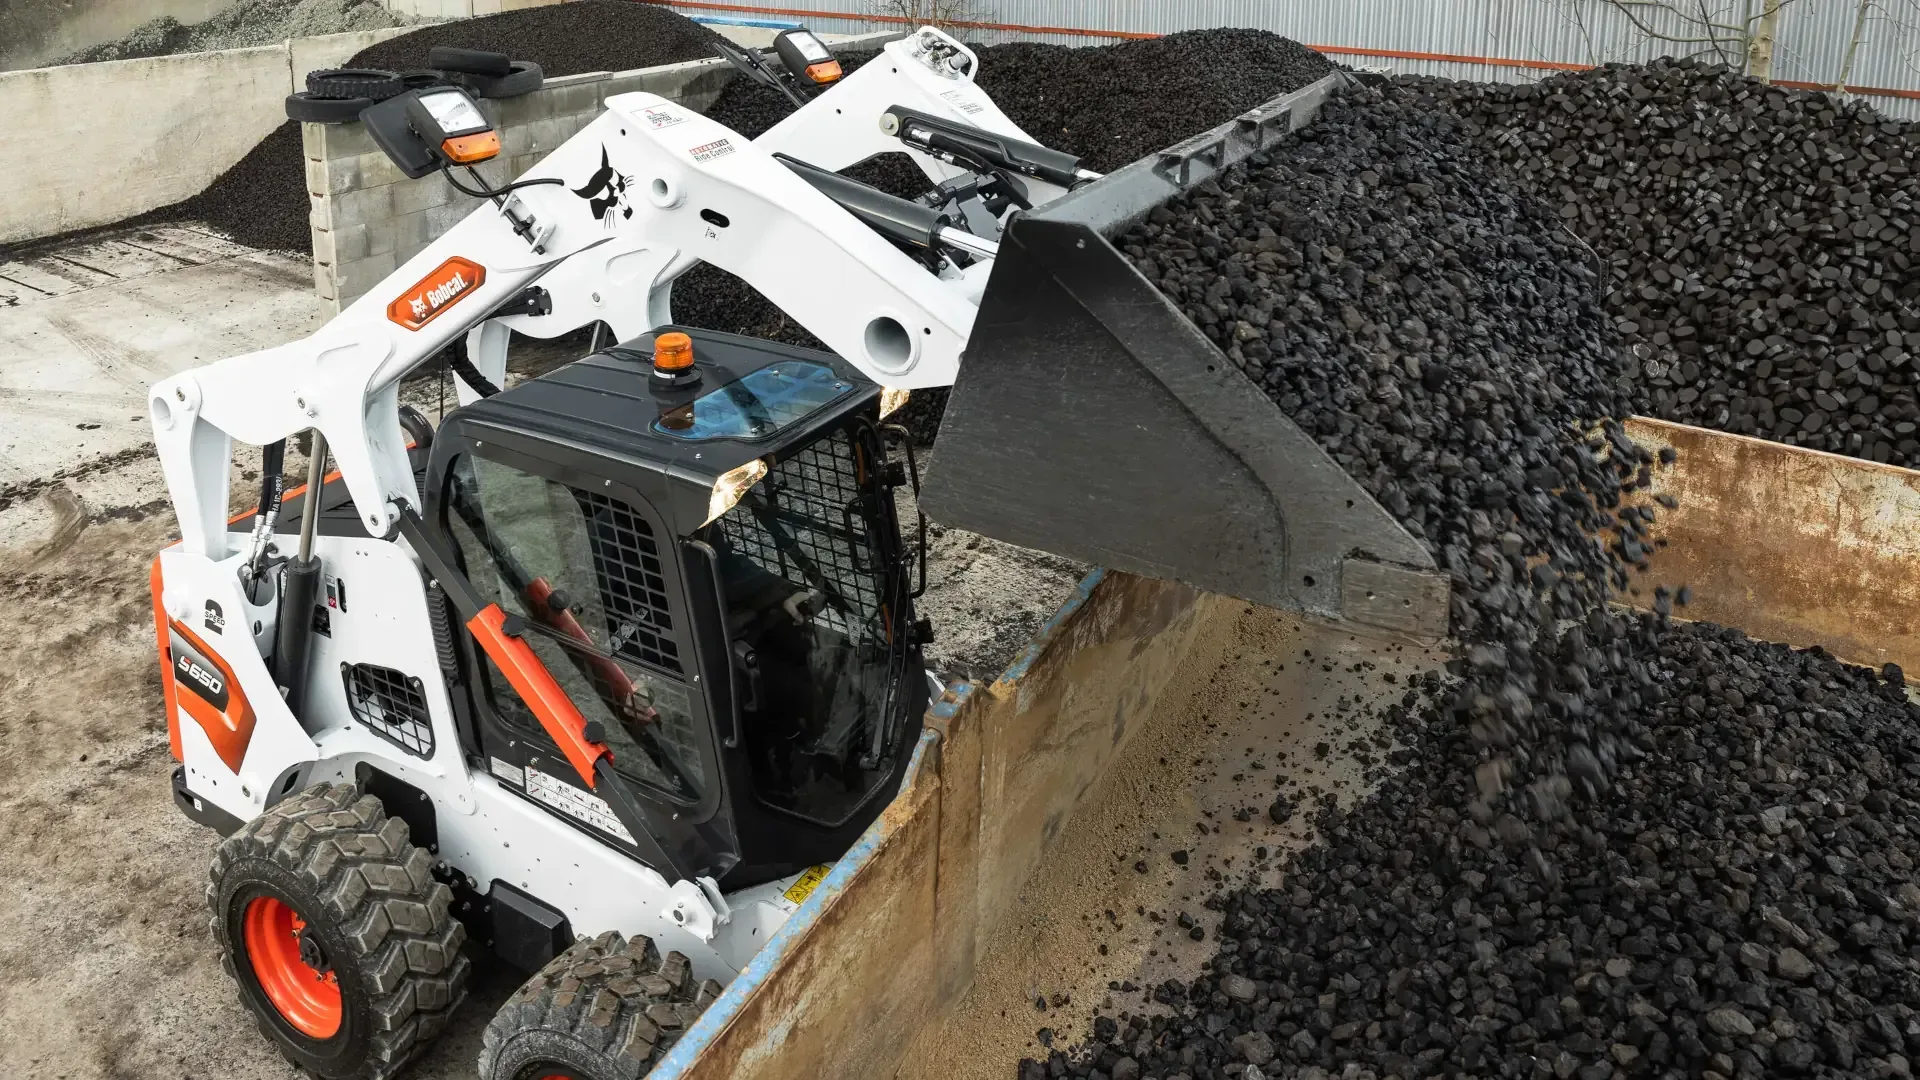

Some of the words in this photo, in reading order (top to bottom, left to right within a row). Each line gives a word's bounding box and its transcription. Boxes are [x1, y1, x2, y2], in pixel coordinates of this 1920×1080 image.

[694, 153, 711, 163] Ride
[710, 145, 735, 157] Control
[204, 610, 226, 626] SPEED
[178, 655, 222, 694] S650
